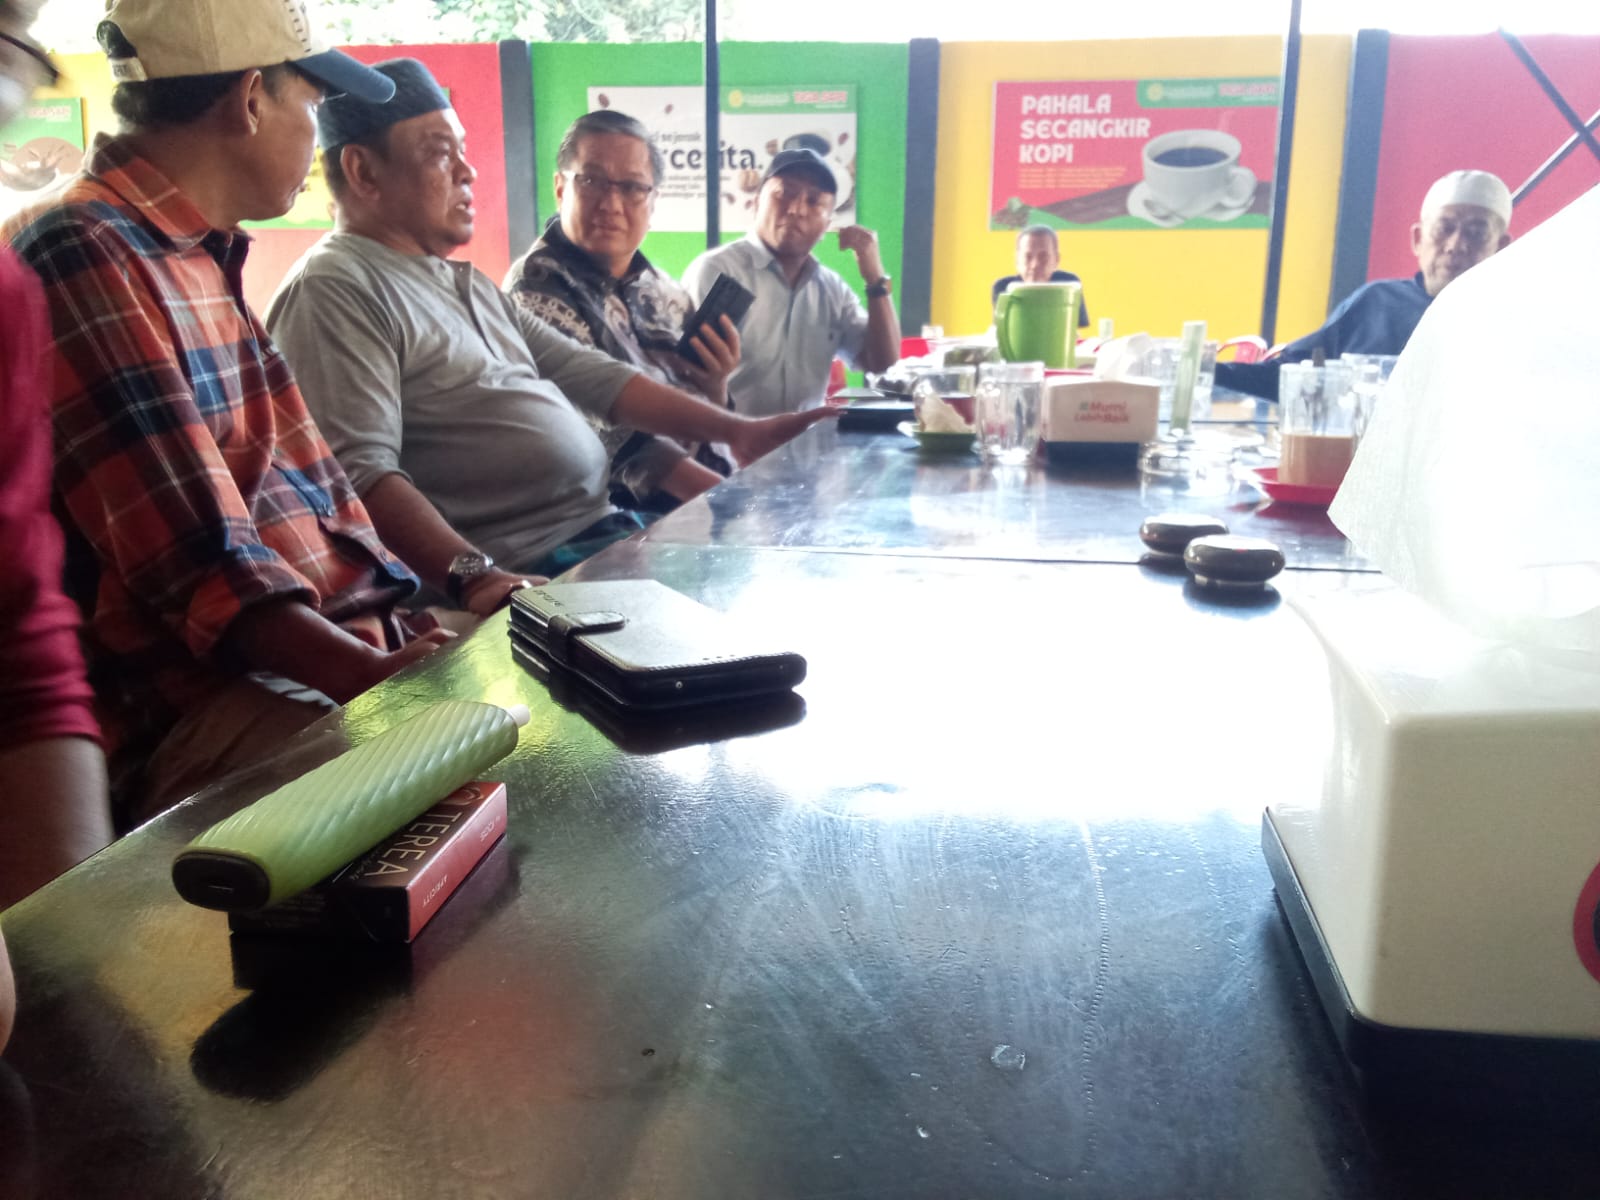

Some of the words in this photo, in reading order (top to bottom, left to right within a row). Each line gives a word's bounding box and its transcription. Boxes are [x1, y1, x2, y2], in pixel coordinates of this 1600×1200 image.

[1021, 93, 1111, 115] PAHALA
[1020, 117, 1151, 139] SECANGKIR
[1019, 143, 1074, 164] KOPI
[364, 811, 462, 877] TEREA
